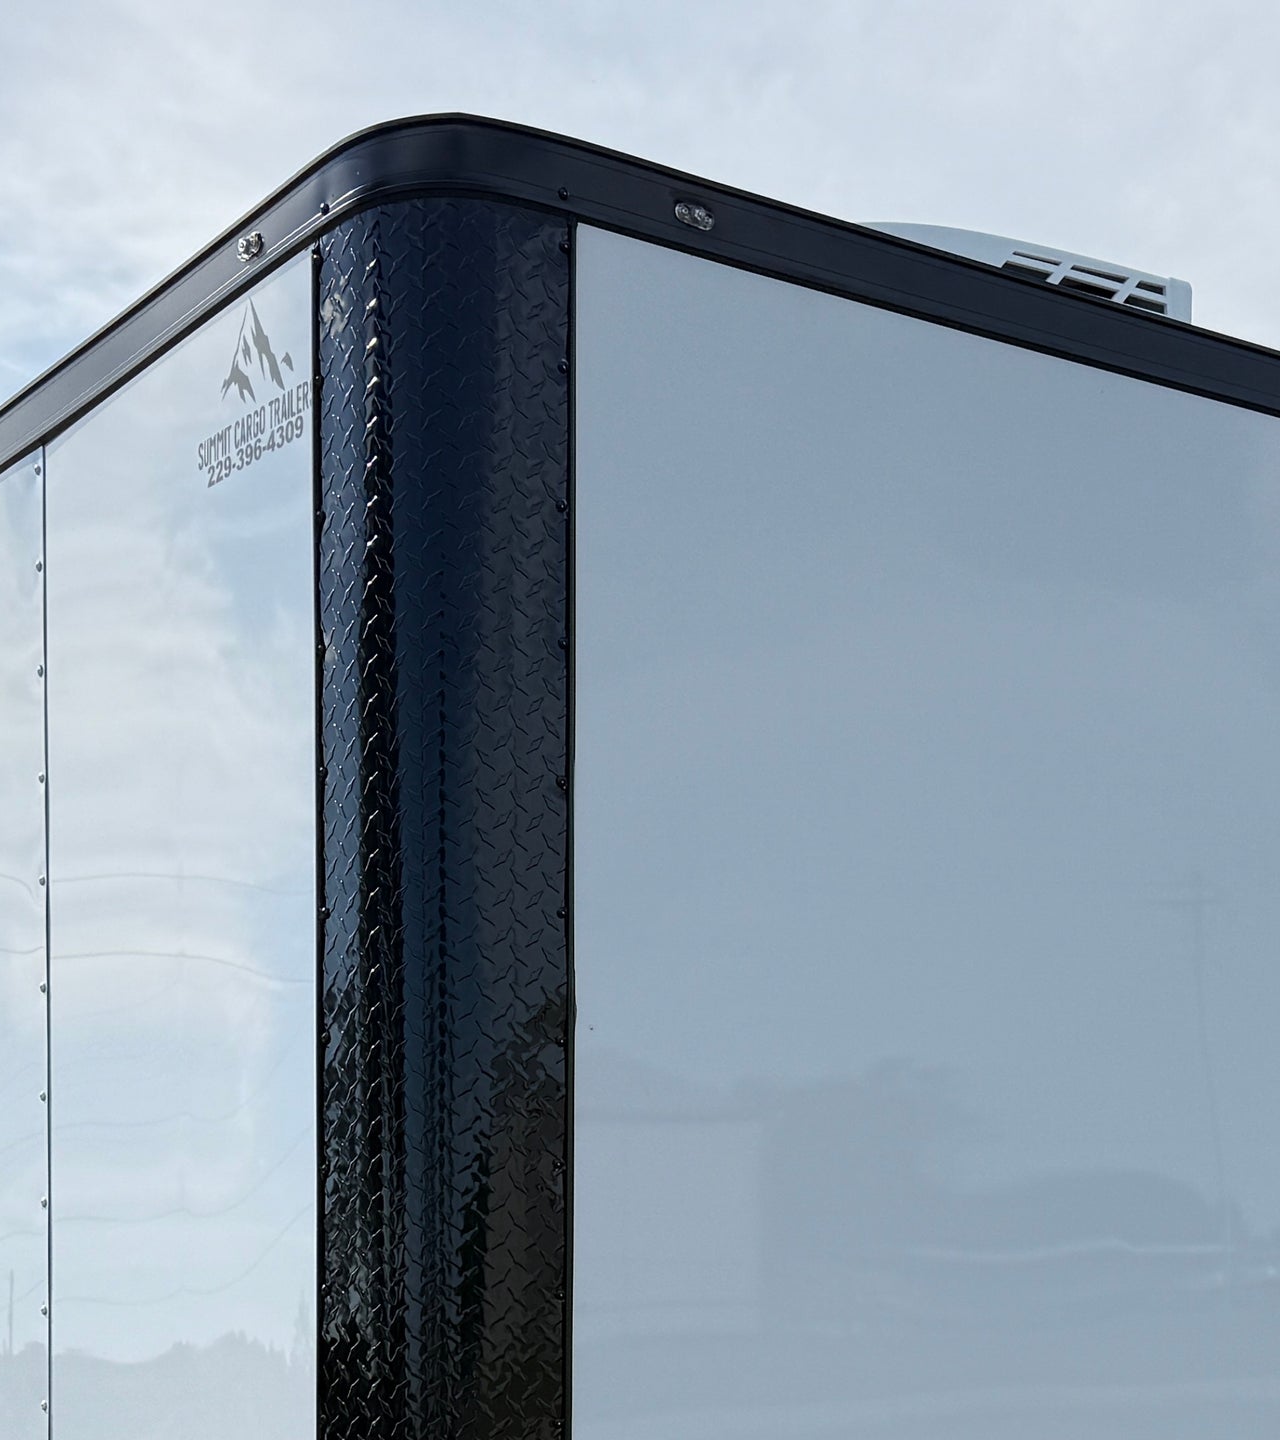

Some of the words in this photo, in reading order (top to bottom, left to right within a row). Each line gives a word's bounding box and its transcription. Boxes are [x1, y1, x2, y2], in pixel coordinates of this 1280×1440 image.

[198, 425, 232, 470] SUMMIT
[234, 406, 266, 450] CARGO
[207, 415, 304, 488] 229-396-4309
